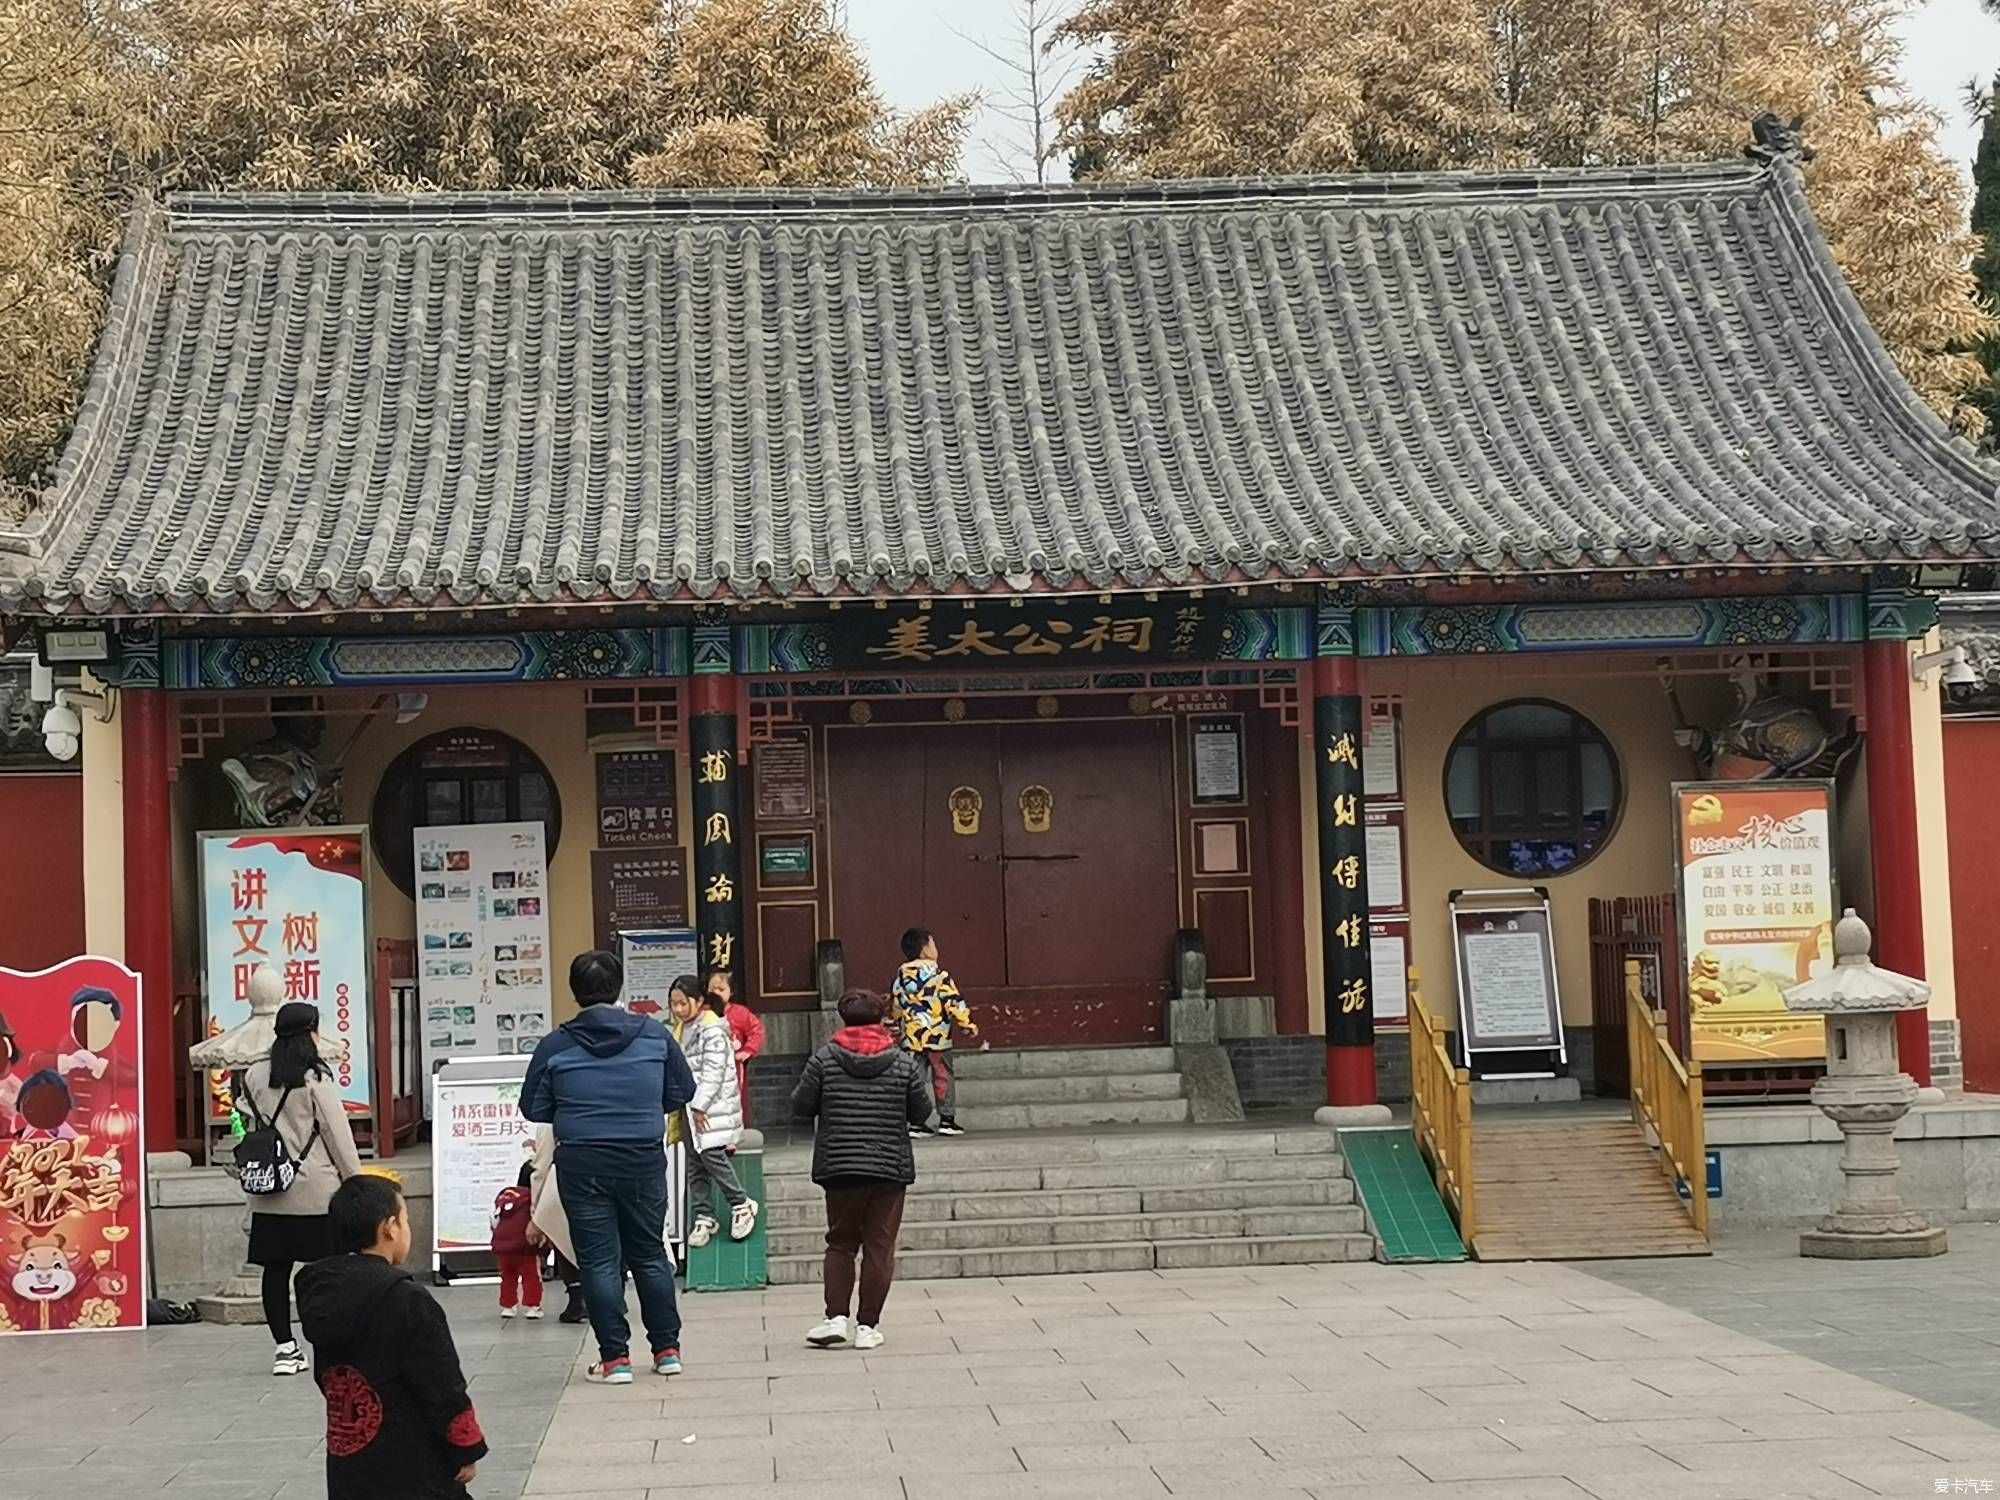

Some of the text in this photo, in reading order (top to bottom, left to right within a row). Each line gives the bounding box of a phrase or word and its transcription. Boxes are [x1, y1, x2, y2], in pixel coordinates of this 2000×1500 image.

[866, 614, 1153, 662] 姜太公祠
[628, 806, 673, 821] 检票口
[604, 832, 673, 842] Ticket Check
[1738, 815, 1807, 849] 核心
[1732, 865, 1753, 878] 民主
[1761, 864, 1783, 877] 文明
[1703, 882, 1812, 898] 自由 平等 公正 法治
[1704, 904, 1726, 917] 爱国
[1792, 901, 1814, 914] 友善
[452, 1103, 520, 1119] 情系雷锋
[452, 1120, 529, 1137] 爱洒三月天
[8, 1135, 90, 1173] 2021
[0, 1165, 124, 1222] 年大吉
